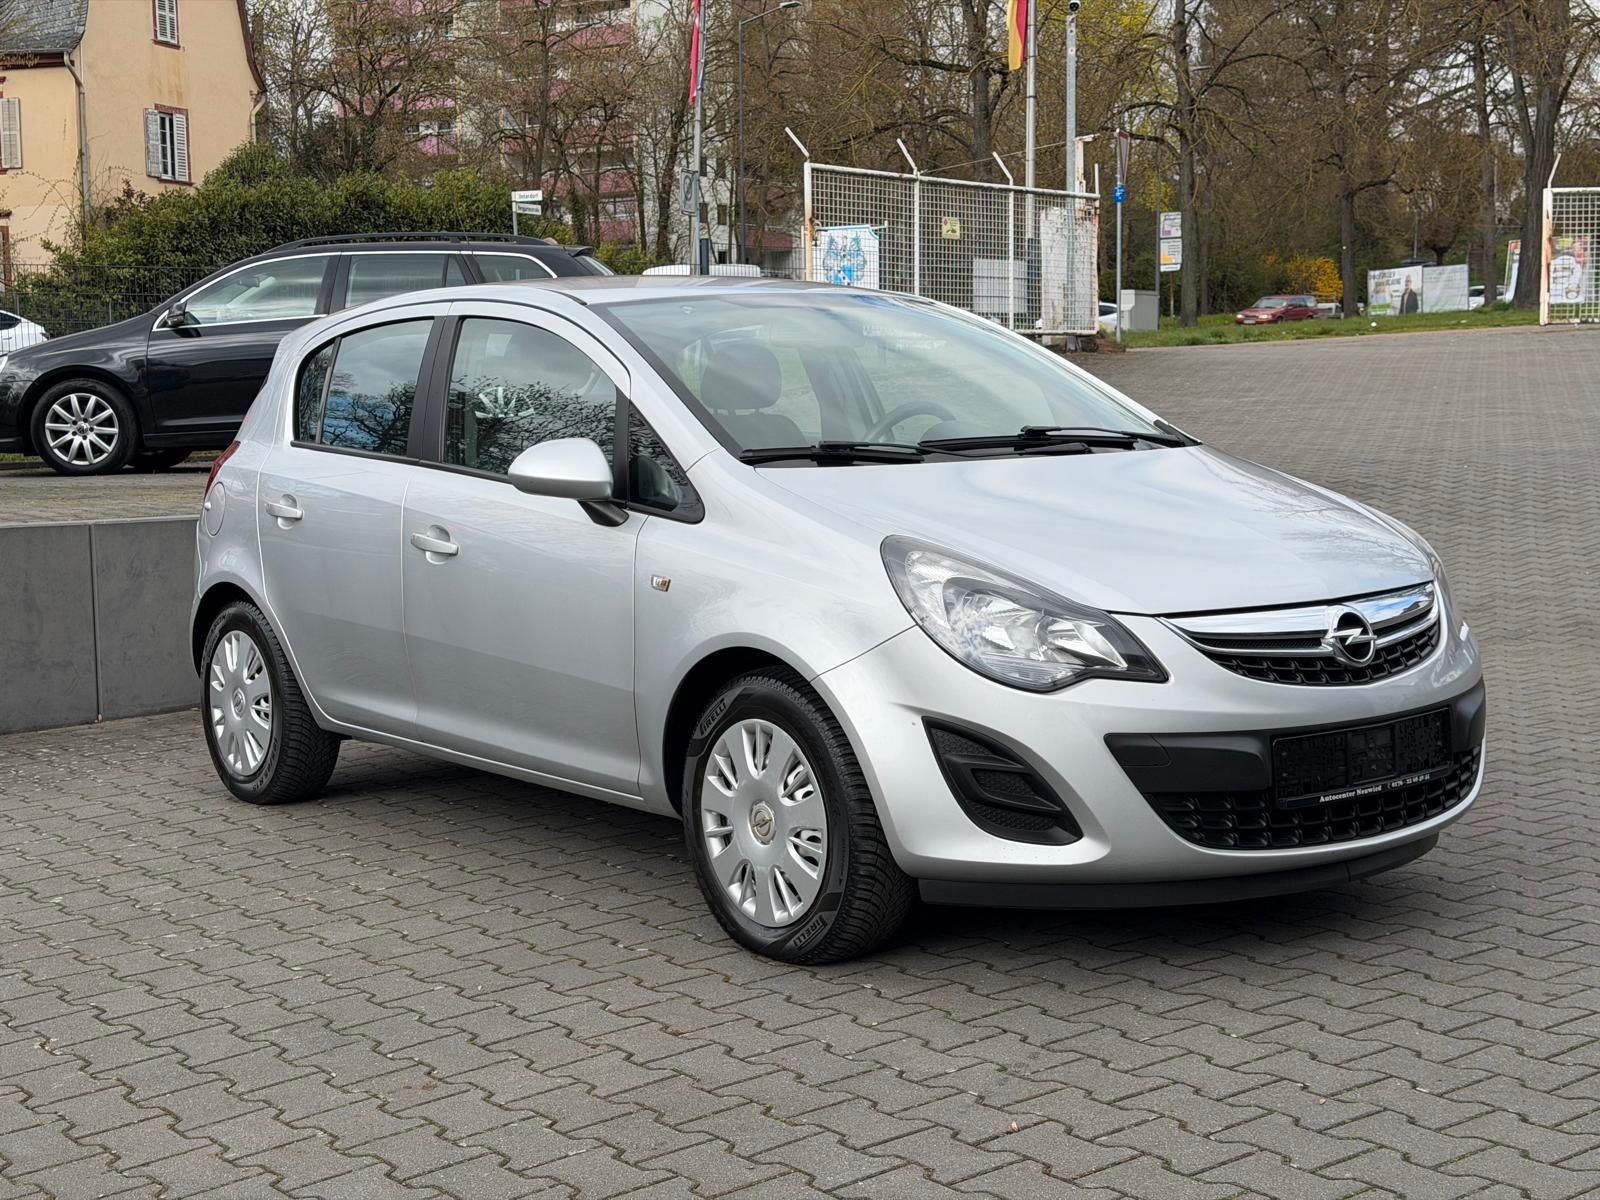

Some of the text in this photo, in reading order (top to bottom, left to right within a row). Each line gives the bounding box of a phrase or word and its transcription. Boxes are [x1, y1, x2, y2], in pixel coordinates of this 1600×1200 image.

[699, 697, 727, 737] PIRELLI
[1320, 791, 1355, 803] Autocenter
[1357, 785, 1382, 796] Neuwied
[792, 914, 828, 949] PIRELLI
